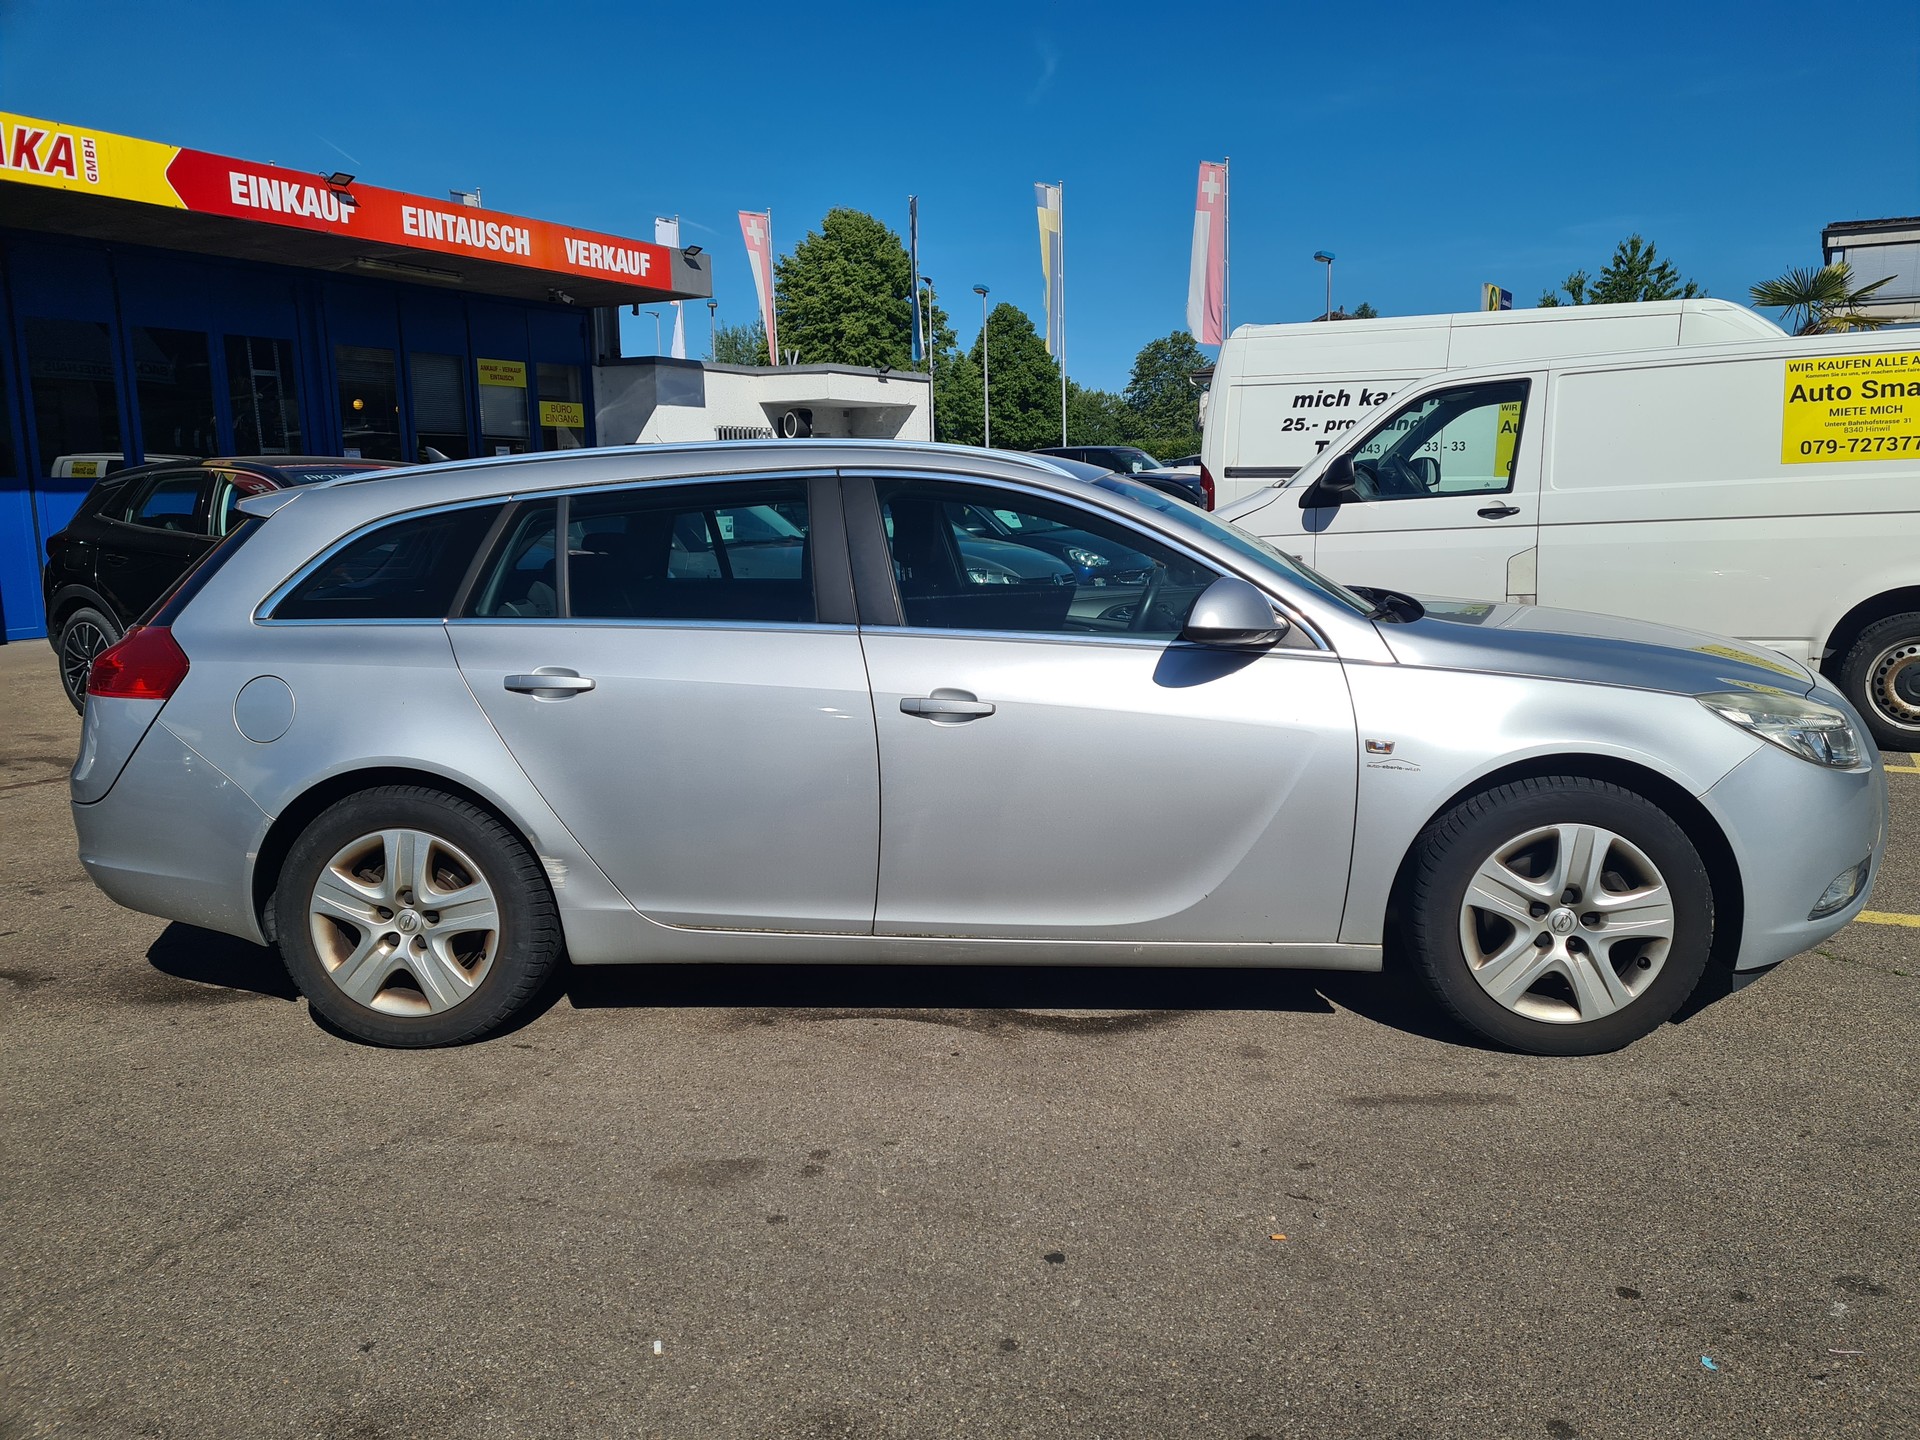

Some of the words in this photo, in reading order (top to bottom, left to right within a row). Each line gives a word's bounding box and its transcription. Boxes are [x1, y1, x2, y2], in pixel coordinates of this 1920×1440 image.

[0, 125, 77, 178] KA
[82, 138, 99, 183] GMBH
[229, 171, 355, 223] EINKAUF
[401, 205, 531, 256] EINTAUSCH
[563, 237, 650, 277] VERKAUF
[1789, 362, 1813, 372] WIR
[1818, 359, 1871, 371] KAUFEN
[1875, 356, 1908, 367] ALLE
[1292, 390, 1351, 408] mich
[1789, 384, 1852, 403] Auto
[1861, 380, 1920, 399] Sma
[551, 403, 572, 414] BÜRO
[1501, 404, 1518, 412] WIR
[1829, 406, 1867, 417] MIETE
[1870, 405, 1903, 415] MICH
[545, 414, 579, 424] EINGANG
[1281, 417, 1319, 432] 25.-
[1324, 419, 1357, 434] pro
[1848, 418, 1900, 426] Bahnhofstrasse
[1843, 426, 1864, 434] 8340
[1866, 425, 1891, 433] Hinwil
[1451, 441, 1466, 452] 33
